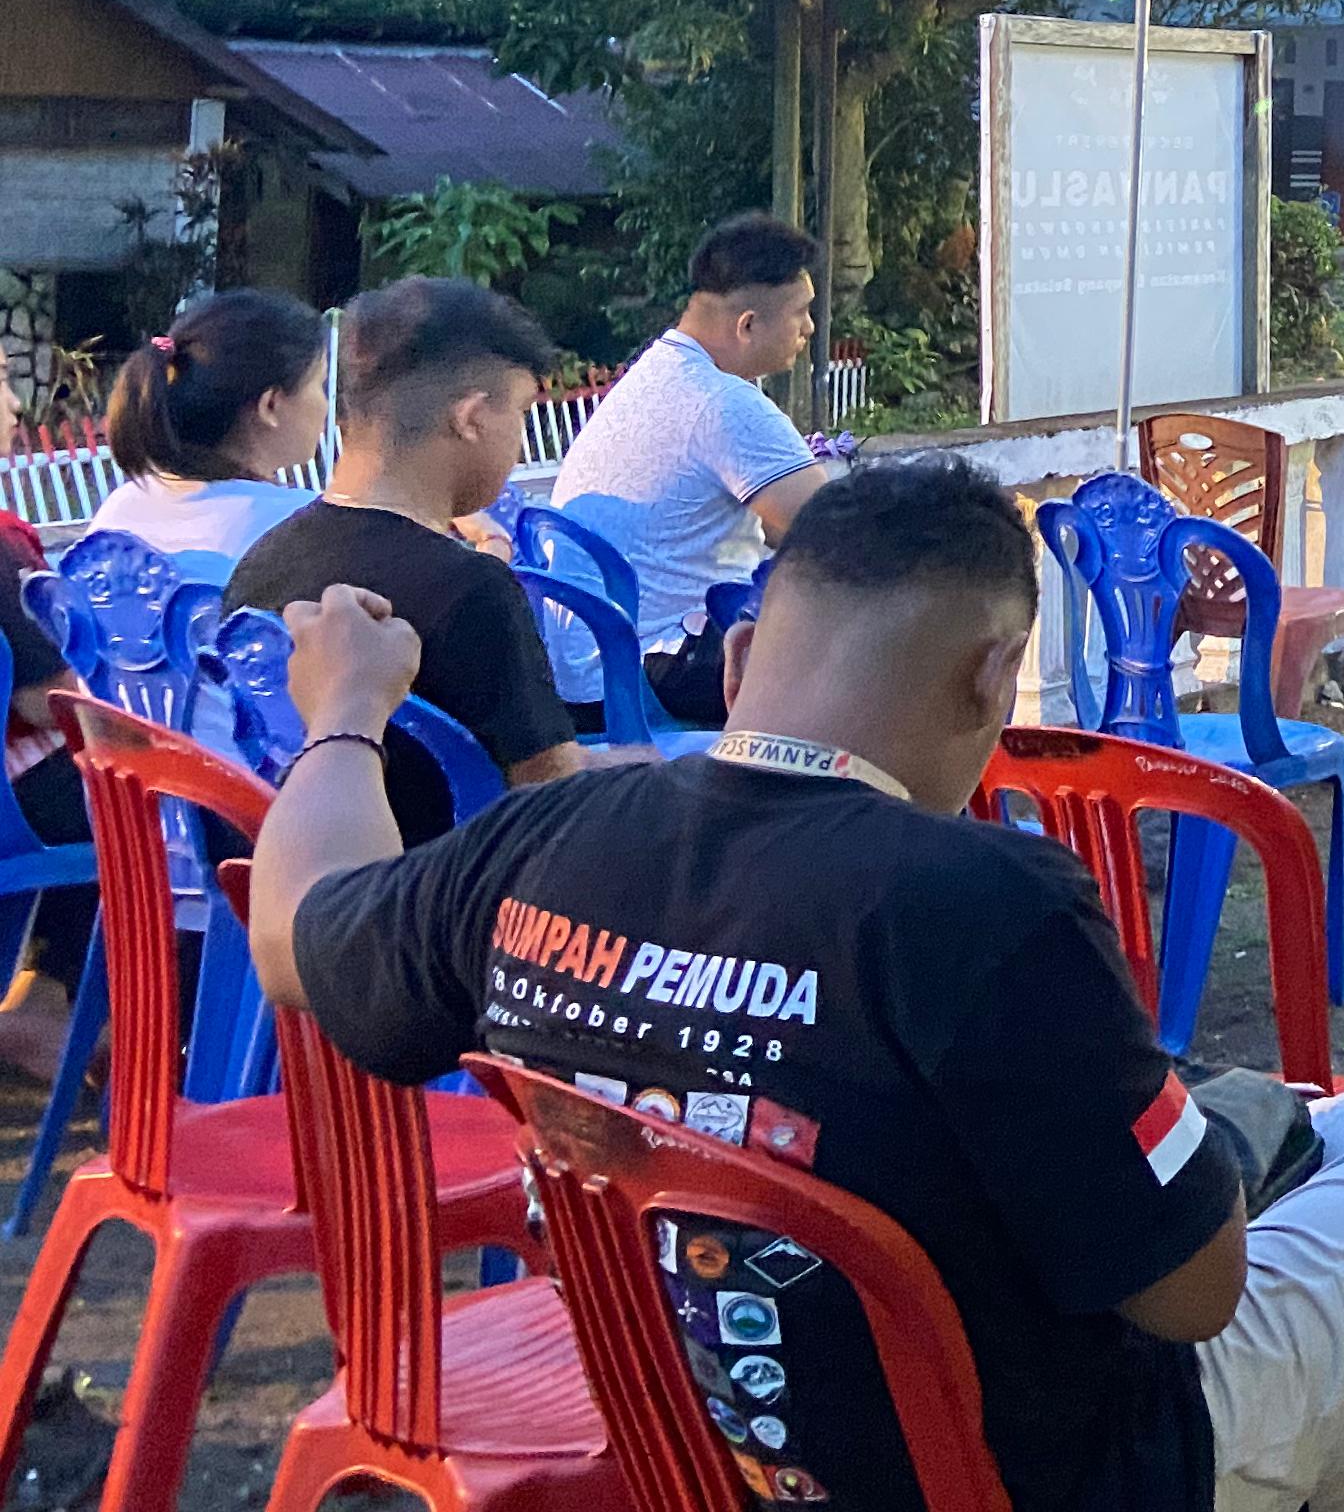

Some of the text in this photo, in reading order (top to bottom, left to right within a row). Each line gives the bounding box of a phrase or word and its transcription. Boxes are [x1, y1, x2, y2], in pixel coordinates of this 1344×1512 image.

[492, 896, 818, 1026] SUMPAH PEMUDA
[677, 1025, 784, 1062] 1928
